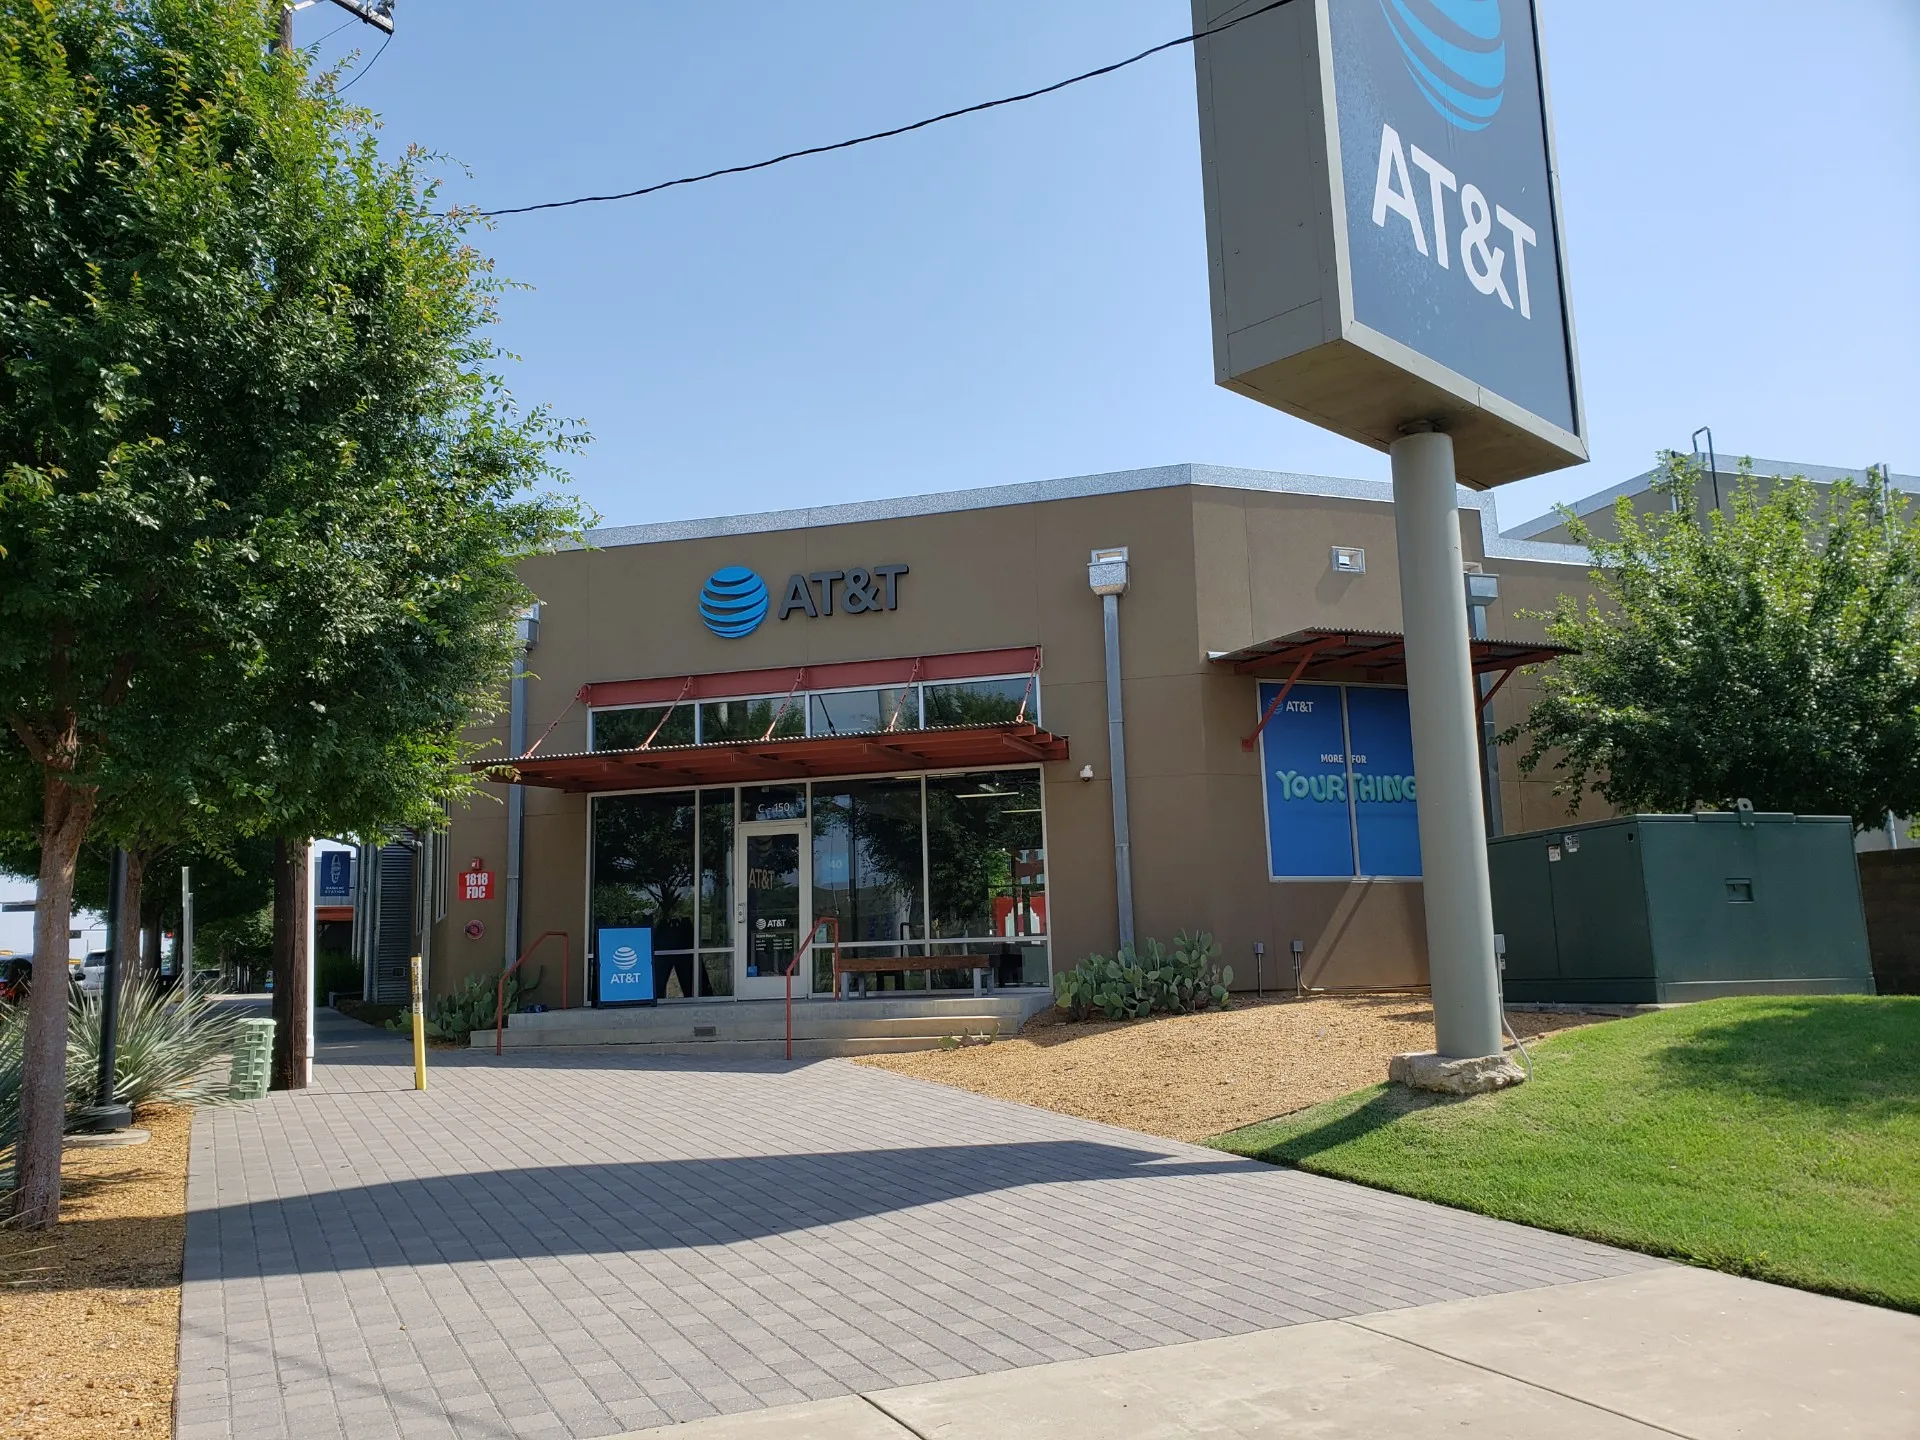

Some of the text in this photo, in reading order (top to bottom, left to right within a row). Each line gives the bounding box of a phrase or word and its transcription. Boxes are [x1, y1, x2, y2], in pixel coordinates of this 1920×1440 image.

[1372, 123, 1537, 320] AT&T
[778, 564, 909, 620] AT&T
[1285, 700, 1314, 713] AT&T
[1320, 754, 1367, 764] MORE FOR
[757, 803, 765, 813] C
[773, 802, 790, 813] 150
[464, 872, 489, 887] 1818
[748, 867, 775, 890] AT&T
[466, 885, 486, 899] FDC
[767, 918, 787, 928] AT&T
[610, 972, 641, 985] AT&T
